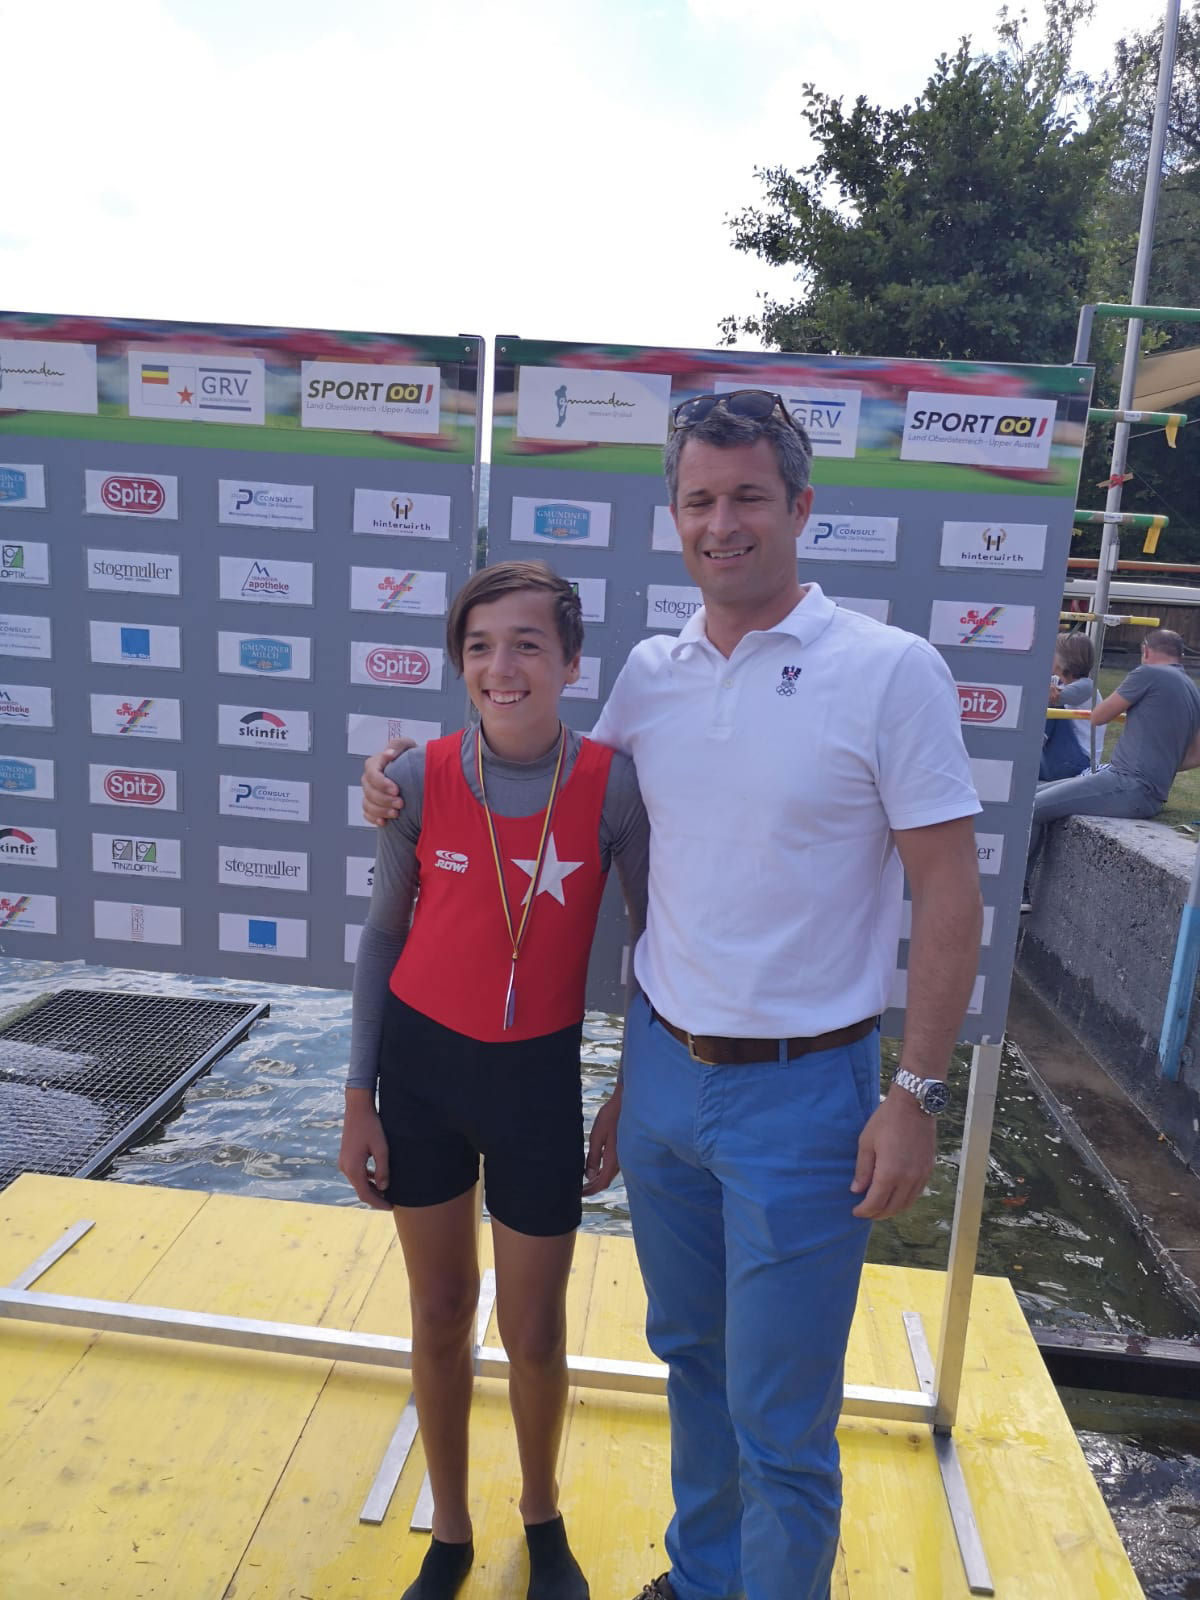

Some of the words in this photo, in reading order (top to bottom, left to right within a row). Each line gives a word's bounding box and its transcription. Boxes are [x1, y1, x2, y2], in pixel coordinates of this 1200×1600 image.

[201, 376, 248, 396] GRV
[307, 380, 383, 401] SPORT
[791, 408, 842, 428] GRV
[911, 410, 994, 434] SPORT
[108, 481, 158, 507] Spitz
[372, 519, 431, 531] hinterwirth
[839, 528, 877, 536] CONSULT
[961, 551, 1025, 562] hinterwirth
[248, 580, 290, 591] apotheke
[372, 653, 423, 677] Spitz
[239, 725, 287, 741] skinfit
[111, 775, 159, 798] Spitz
[257, 790, 290, 798] CONSULT
